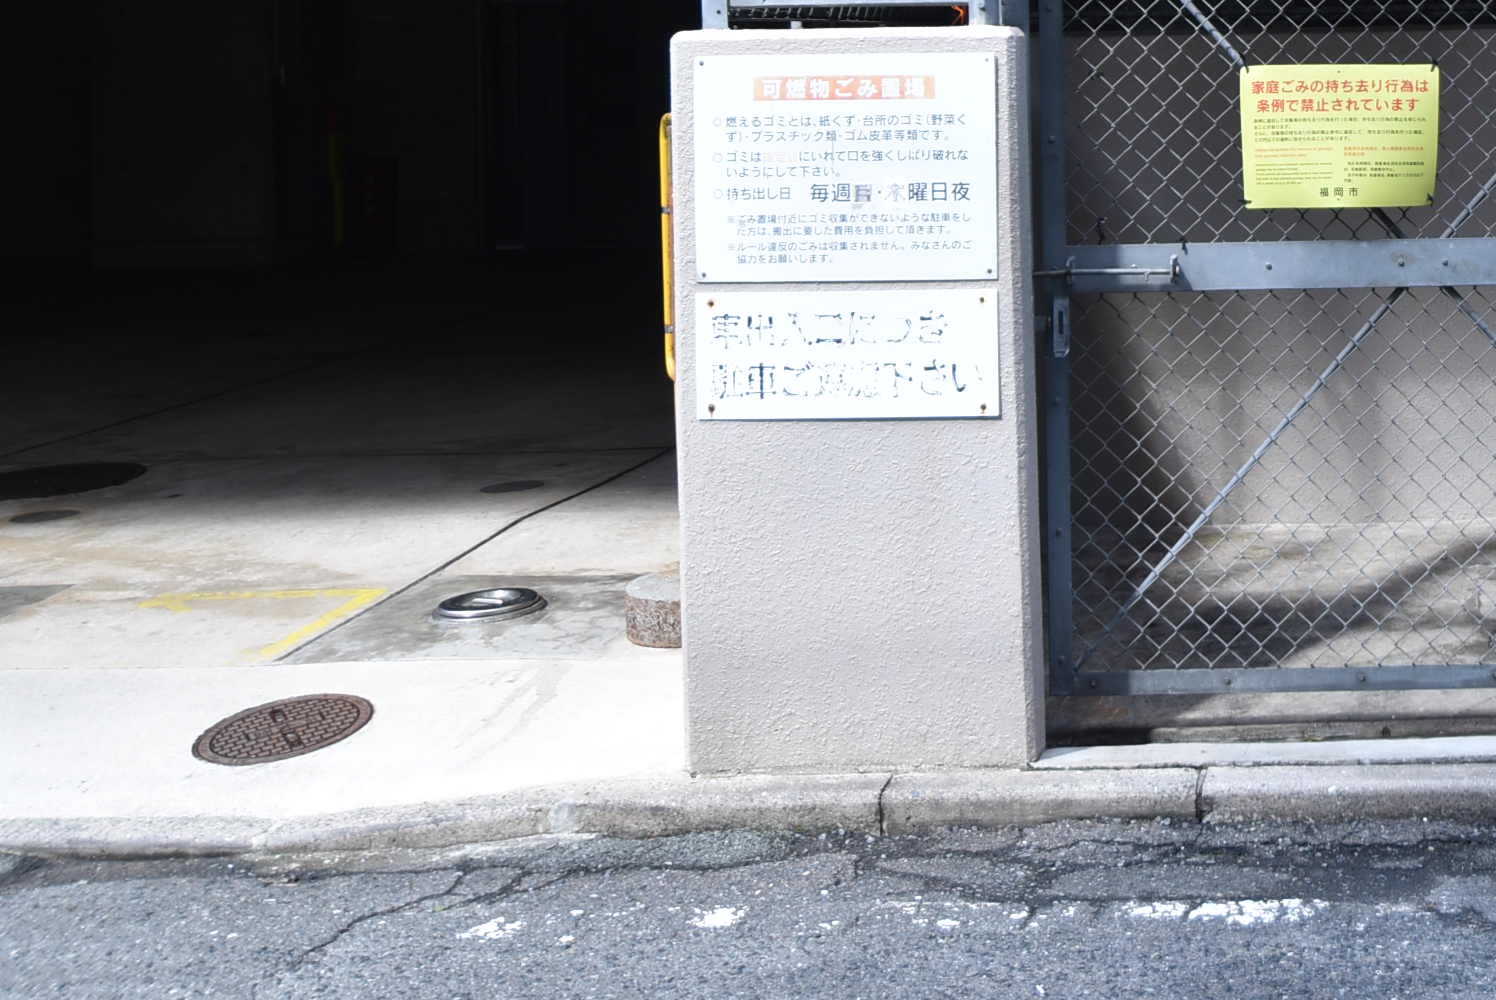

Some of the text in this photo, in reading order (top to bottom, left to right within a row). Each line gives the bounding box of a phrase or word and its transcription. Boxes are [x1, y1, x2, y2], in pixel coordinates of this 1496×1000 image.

[1251, 80, 1429, 94] 家庭ごみの持ち去り行為は
[1257, 98, 1419, 112] 条例で禁止されています
[726, 165, 841, 178] いようにして下さい。
[726, 186, 791, 200] 持ち出し日
